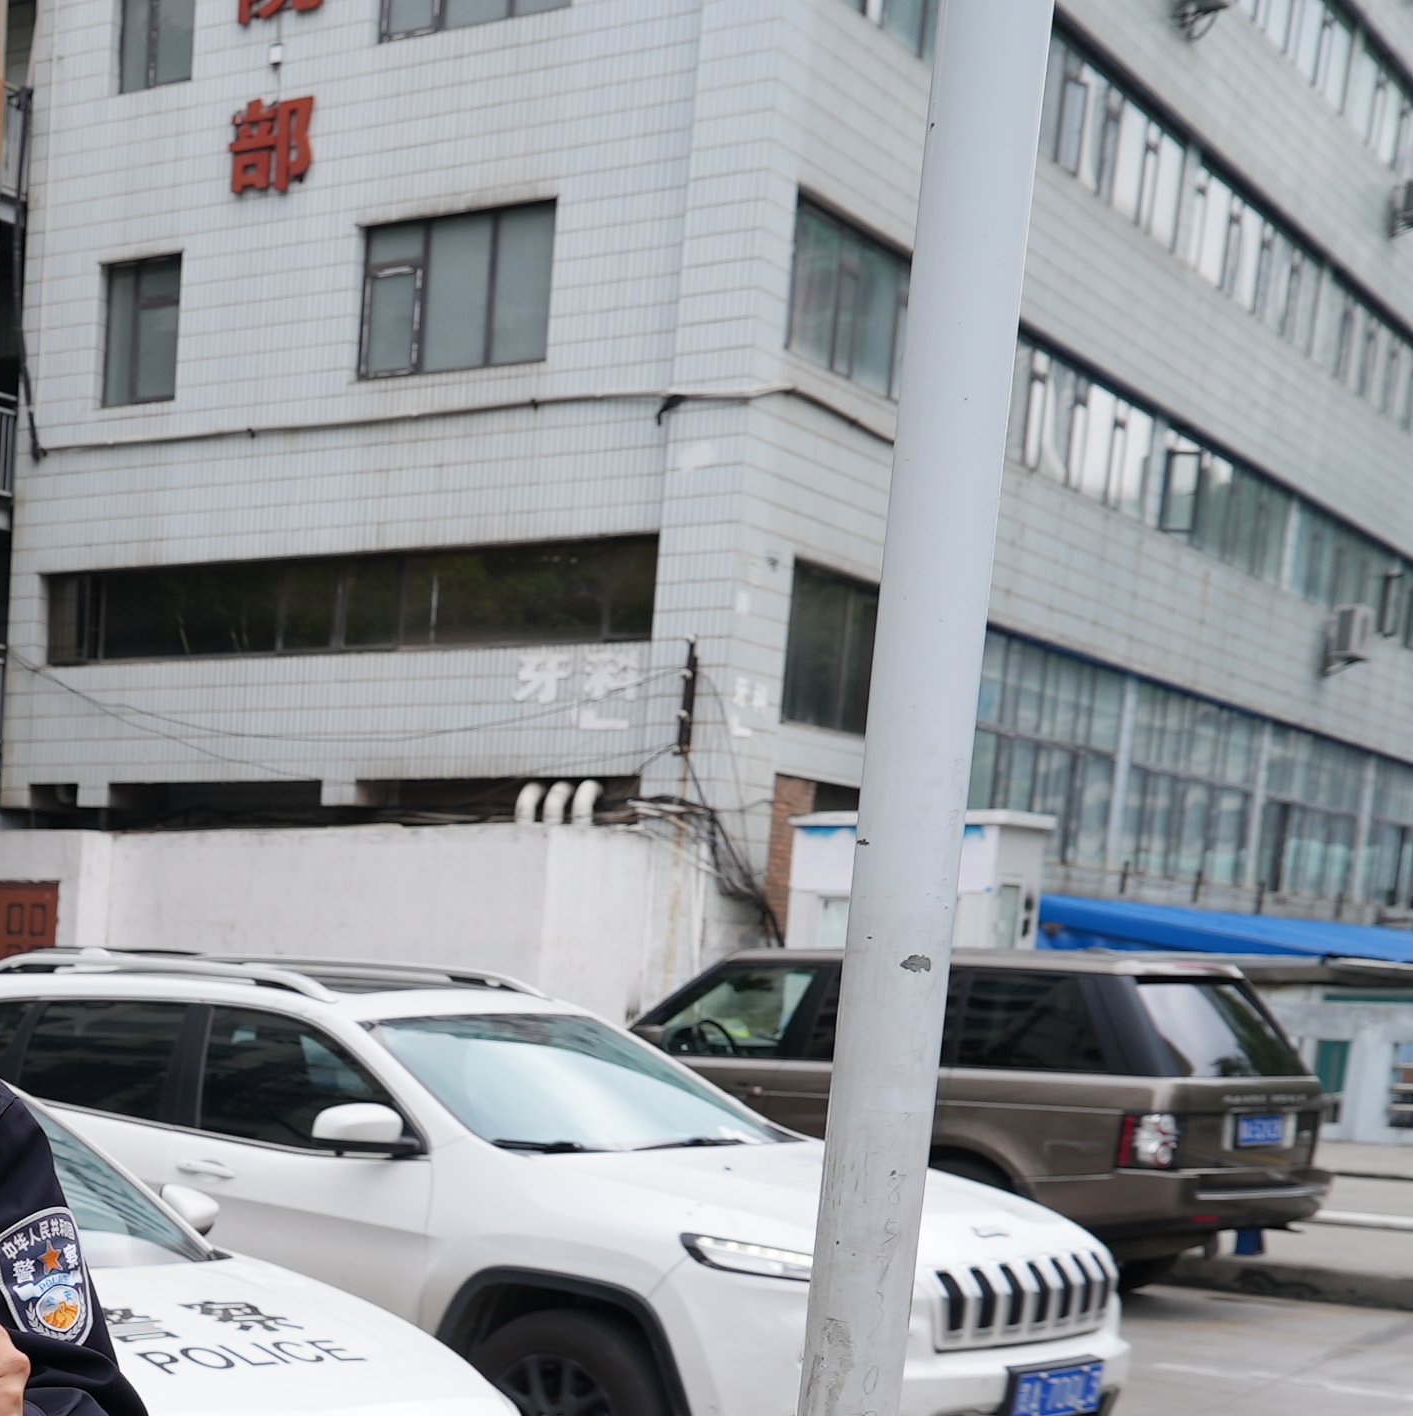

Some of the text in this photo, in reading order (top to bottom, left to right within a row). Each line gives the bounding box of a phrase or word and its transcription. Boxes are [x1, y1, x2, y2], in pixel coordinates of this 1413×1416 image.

[1, 1217, 75, 1260] 中华人民共和国
[134, 1340, 366, 1375] POLICE
